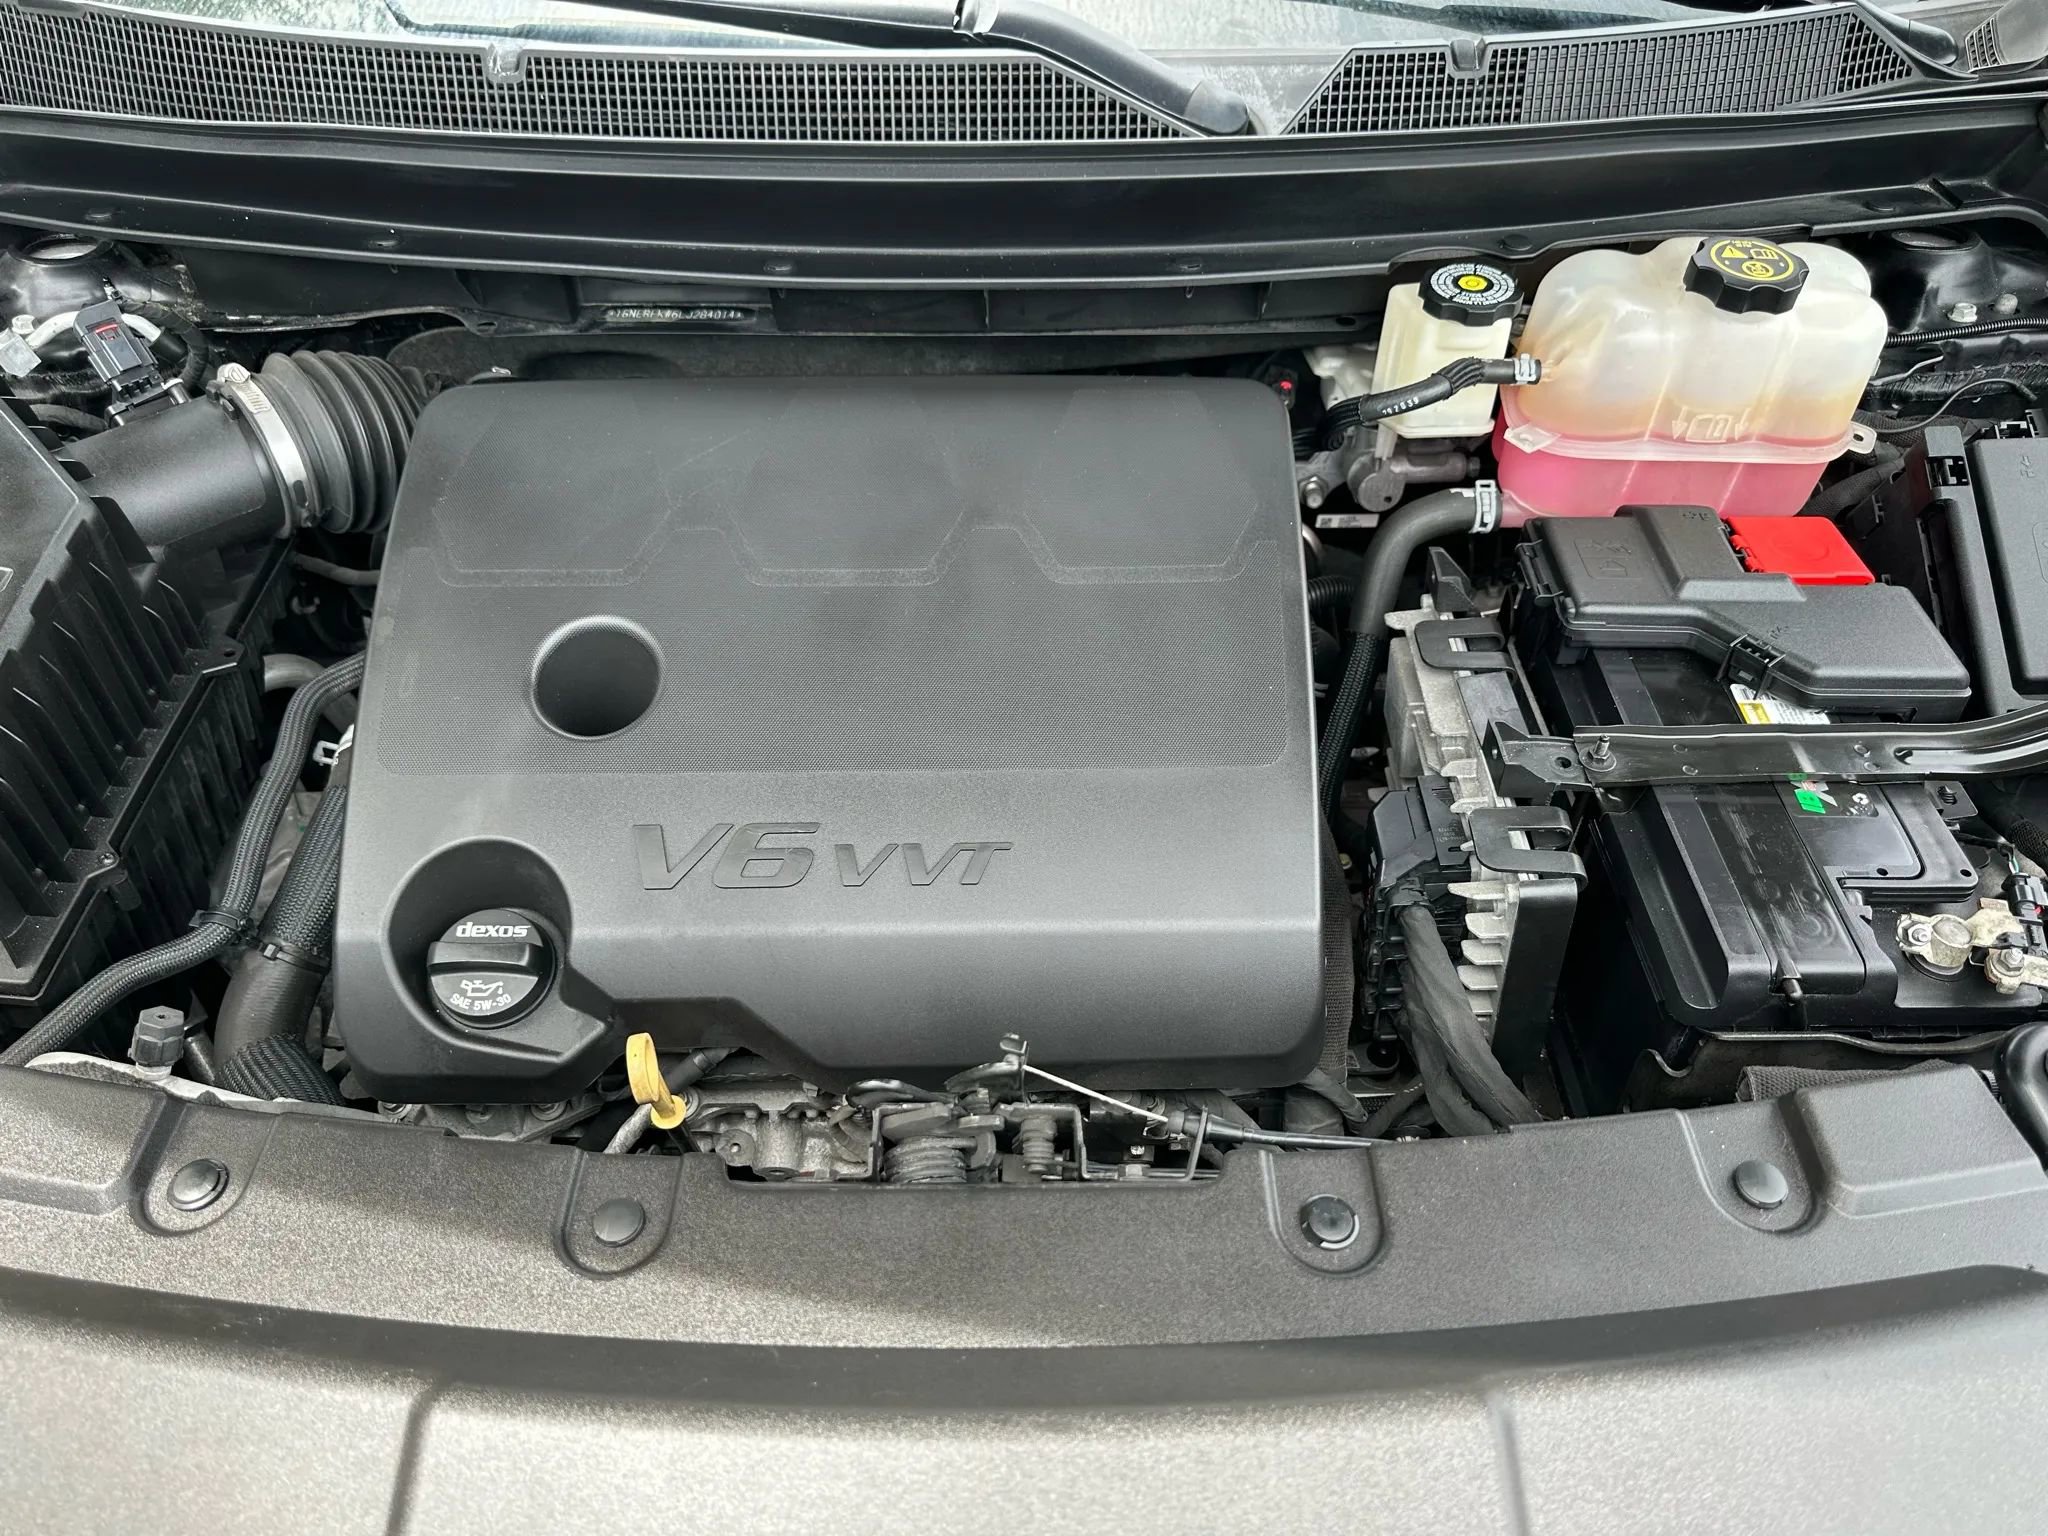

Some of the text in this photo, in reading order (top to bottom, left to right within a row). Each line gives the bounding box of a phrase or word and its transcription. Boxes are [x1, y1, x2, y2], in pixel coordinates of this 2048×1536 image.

[632, 822, 1014, 890] V6 VVT
[455, 921, 531, 938] dexos
[450, 993, 512, 1011] SAE 5W-30
